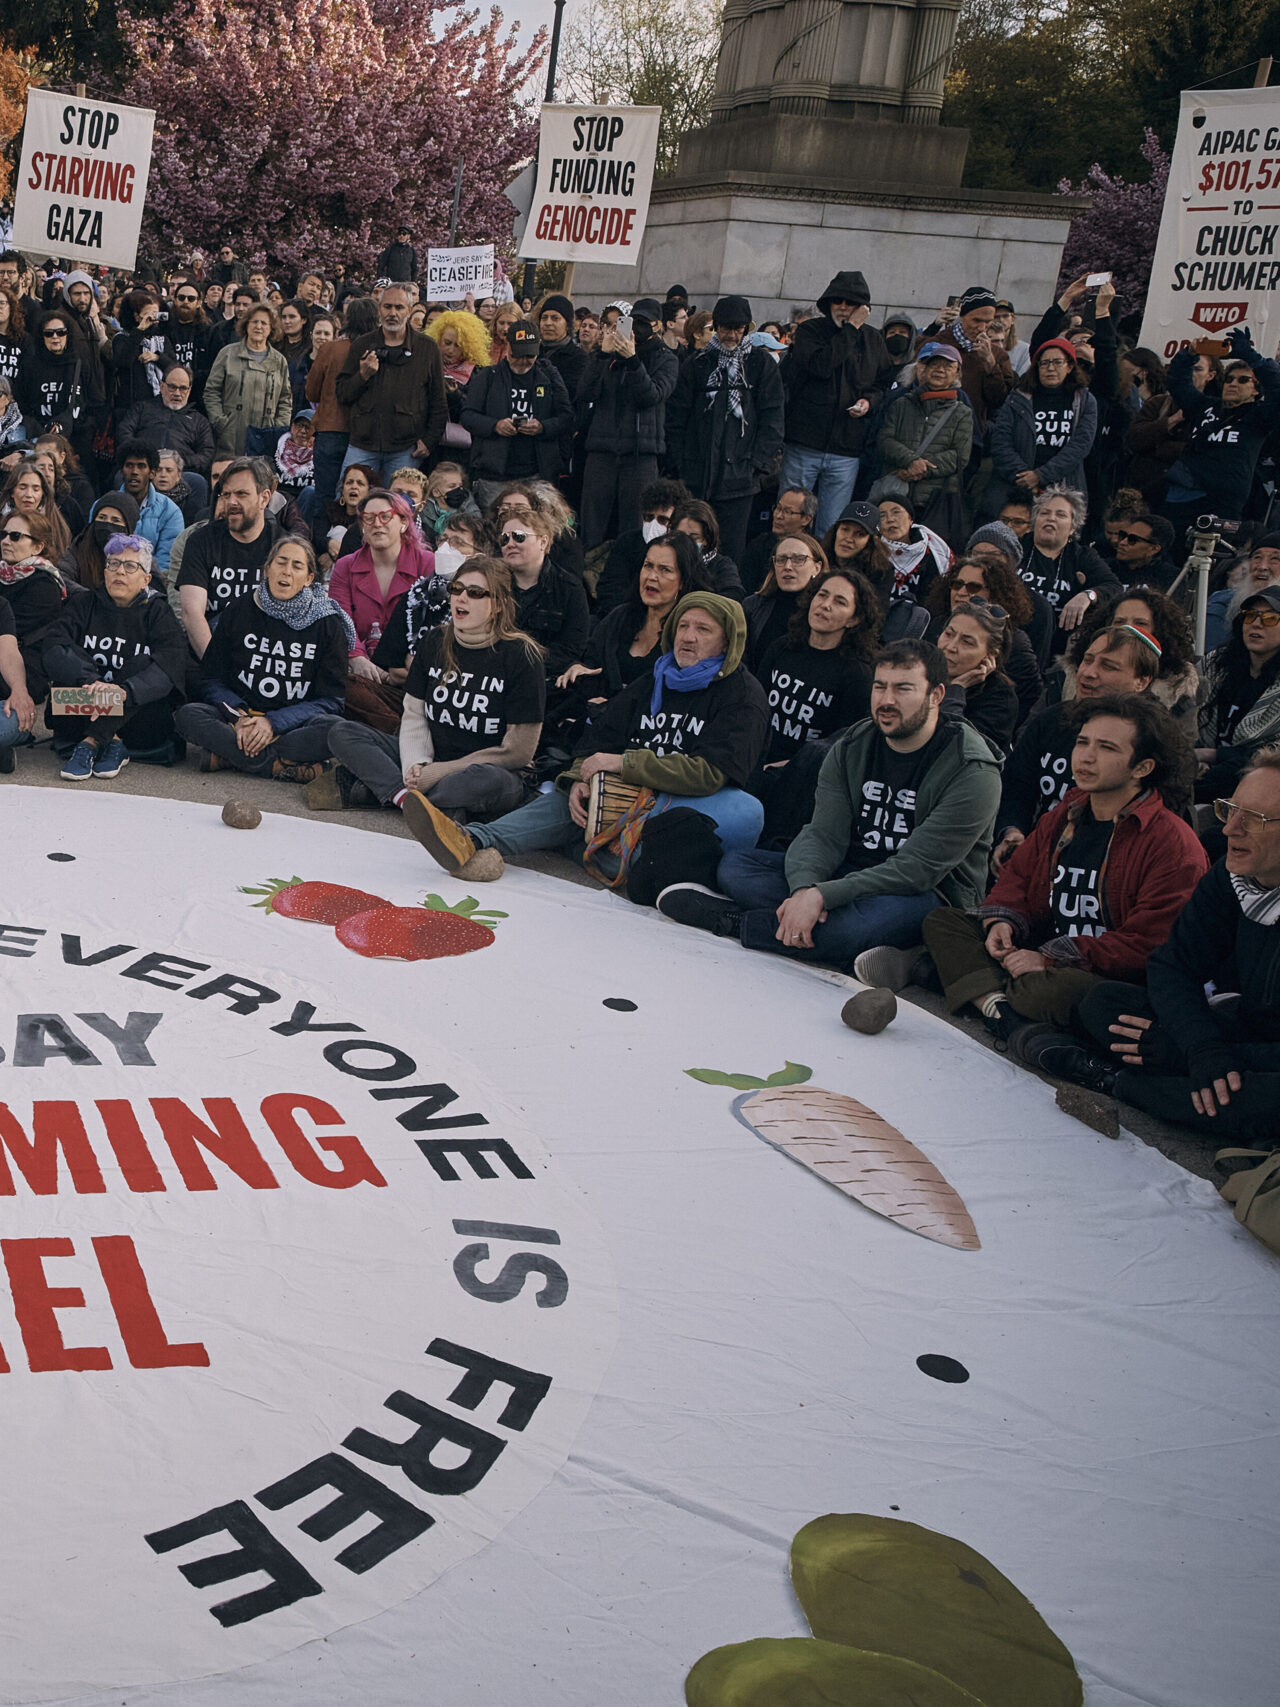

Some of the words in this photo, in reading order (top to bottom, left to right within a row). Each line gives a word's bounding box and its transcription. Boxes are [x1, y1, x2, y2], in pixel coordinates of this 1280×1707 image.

[60, 105, 119, 150] STOP
[573, 115, 624, 152] STOP
[1197, 128, 1260, 156] AIPAC
[28, 151, 135, 204] STARVING
[549, 158, 636, 196] FUNDING
[1233, 200, 1254, 215] TO
[46, 204, 103, 248] GAZA
[535, 204, 637, 246] GENOCIDE
[1195, 225, 1279, 256] CHUCK
[429, 263, 493, 282] CEASEFIRE
[453, 256, 470, 264] JEWS
[460, 283, 475, 292] NOW
[1171, 261, 1280, 291] SCHUMER
[1199, 307, 1240, 322] WHO
[1035, 411, 1058, 420] OT
[211, 565, 248, 581] NOT
[83, 634, 126, 652] NOT
[244, 633, 317, 660] CEASE
[249, 654, 303, 678] FIRE
[428, 666, 474, 687] NOT
[481, 676, 504, 693] IN
[237, 669, 311, 700] NOW
[808, 687, 833, 708] IN
[64, 704, 114, 715] NOW
[433, 685, 489, 713] OUR
[768, 689, 815, 724] OUR
[424, 702, 500, 734] NAME
[640, 712, 683, 730] NOT
[771, 713, 822, 741] AME
[1050, 892, 1100, 919] UR
[452, 1218, 569, 1309] IS
[144, 1338, 553, 1628] FREE
